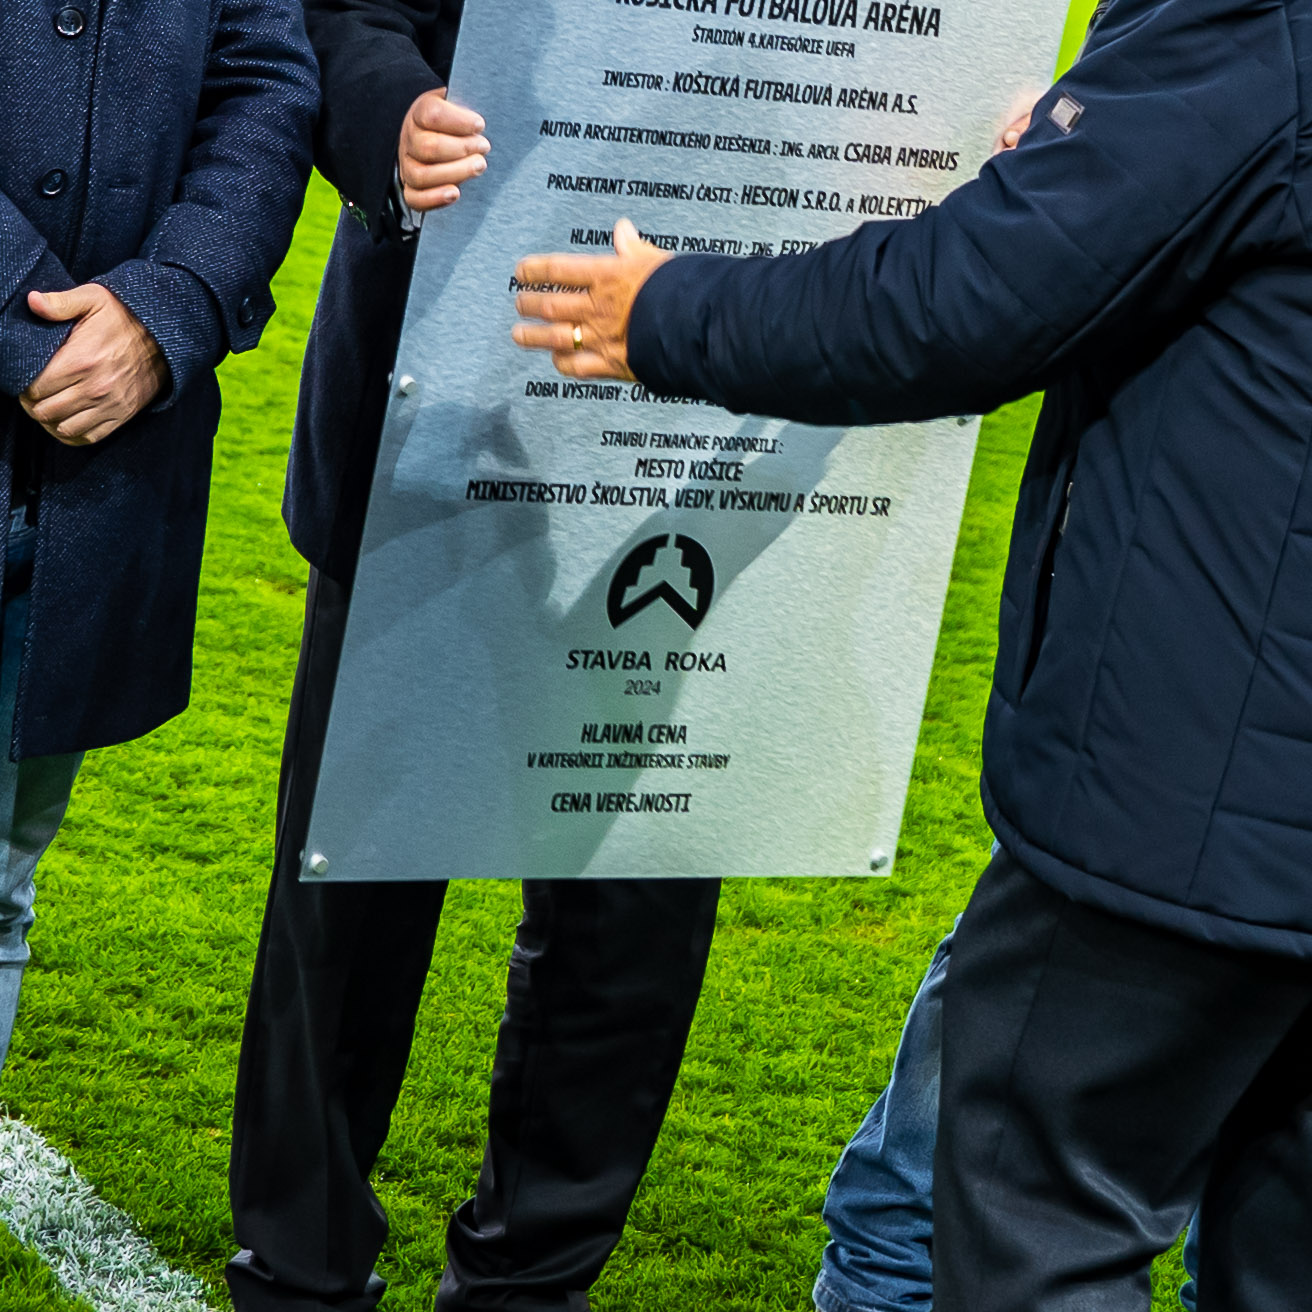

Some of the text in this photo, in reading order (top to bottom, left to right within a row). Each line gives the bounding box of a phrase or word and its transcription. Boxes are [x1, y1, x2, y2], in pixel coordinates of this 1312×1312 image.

[862, 0, 941, 38] ARÉNA
[691, 23, 746, 47] ŠTADIÓN
[825, 40, 856, 59] UEFA
[602, 69, 664, 91] INVESTOR
[672, 70, 740, 98] KOŠICKÁ
[743, 78, 833, 107] FUTBALOVÁ
[835, 87, 888, 112] ARÉNA
[539, 119, 582, 139] AUTOR
[583, 123, 712, 150] ARCHITEKTONICKÉHO
[713, 134, 771, 155] RIEŠENIA
[843, 142, 892, 166] CSABA
[895, 147, 960, 171] AMBRUS
[546, 173, 626, 195] PROJEKTANT
[626, 180, 695, 201] STAVEBNEJ
[696, 183, 733, 204] ČASTI
[740, 184, 800, 209] HESCON
[801, 190, 842, 212] S.R.O.
[845, 197, 855, 213] A
[570, 228, 616, 248] HLAVN
[680, 237, 741, 256] PROJEKTU
[524, 380, 559, 399] DOBA
[561, 381, 622, 402] VÝSTAVBY
[600, 430, 648, 448] STAVBU
[649, 432, 711, 450] FINANČNE
[711, 435, 777, 454] PODPORILI
[634, 457, 745, 483] MESTO KOŠICE
[463, 479, 587, 509] MINISTERSTVO
[719, 487, 792, 513] VÝSKUMU
[790, 492, 806, 513] A
[808, 491, 869, 516] ŠPORTU
[869, 496, 891, 517] SR
[565, 649, 727, 673] STAVBA ROKA
[623, 679, 661, 696] 2024
[580, 720, 687, 745] HLAVNÁ CENA
[527, 749, 731, 770] V KATEGÓRII INŽINIERSKE STAVBY
[550, 792, 692, 813] CENA VEREJNOSTI
